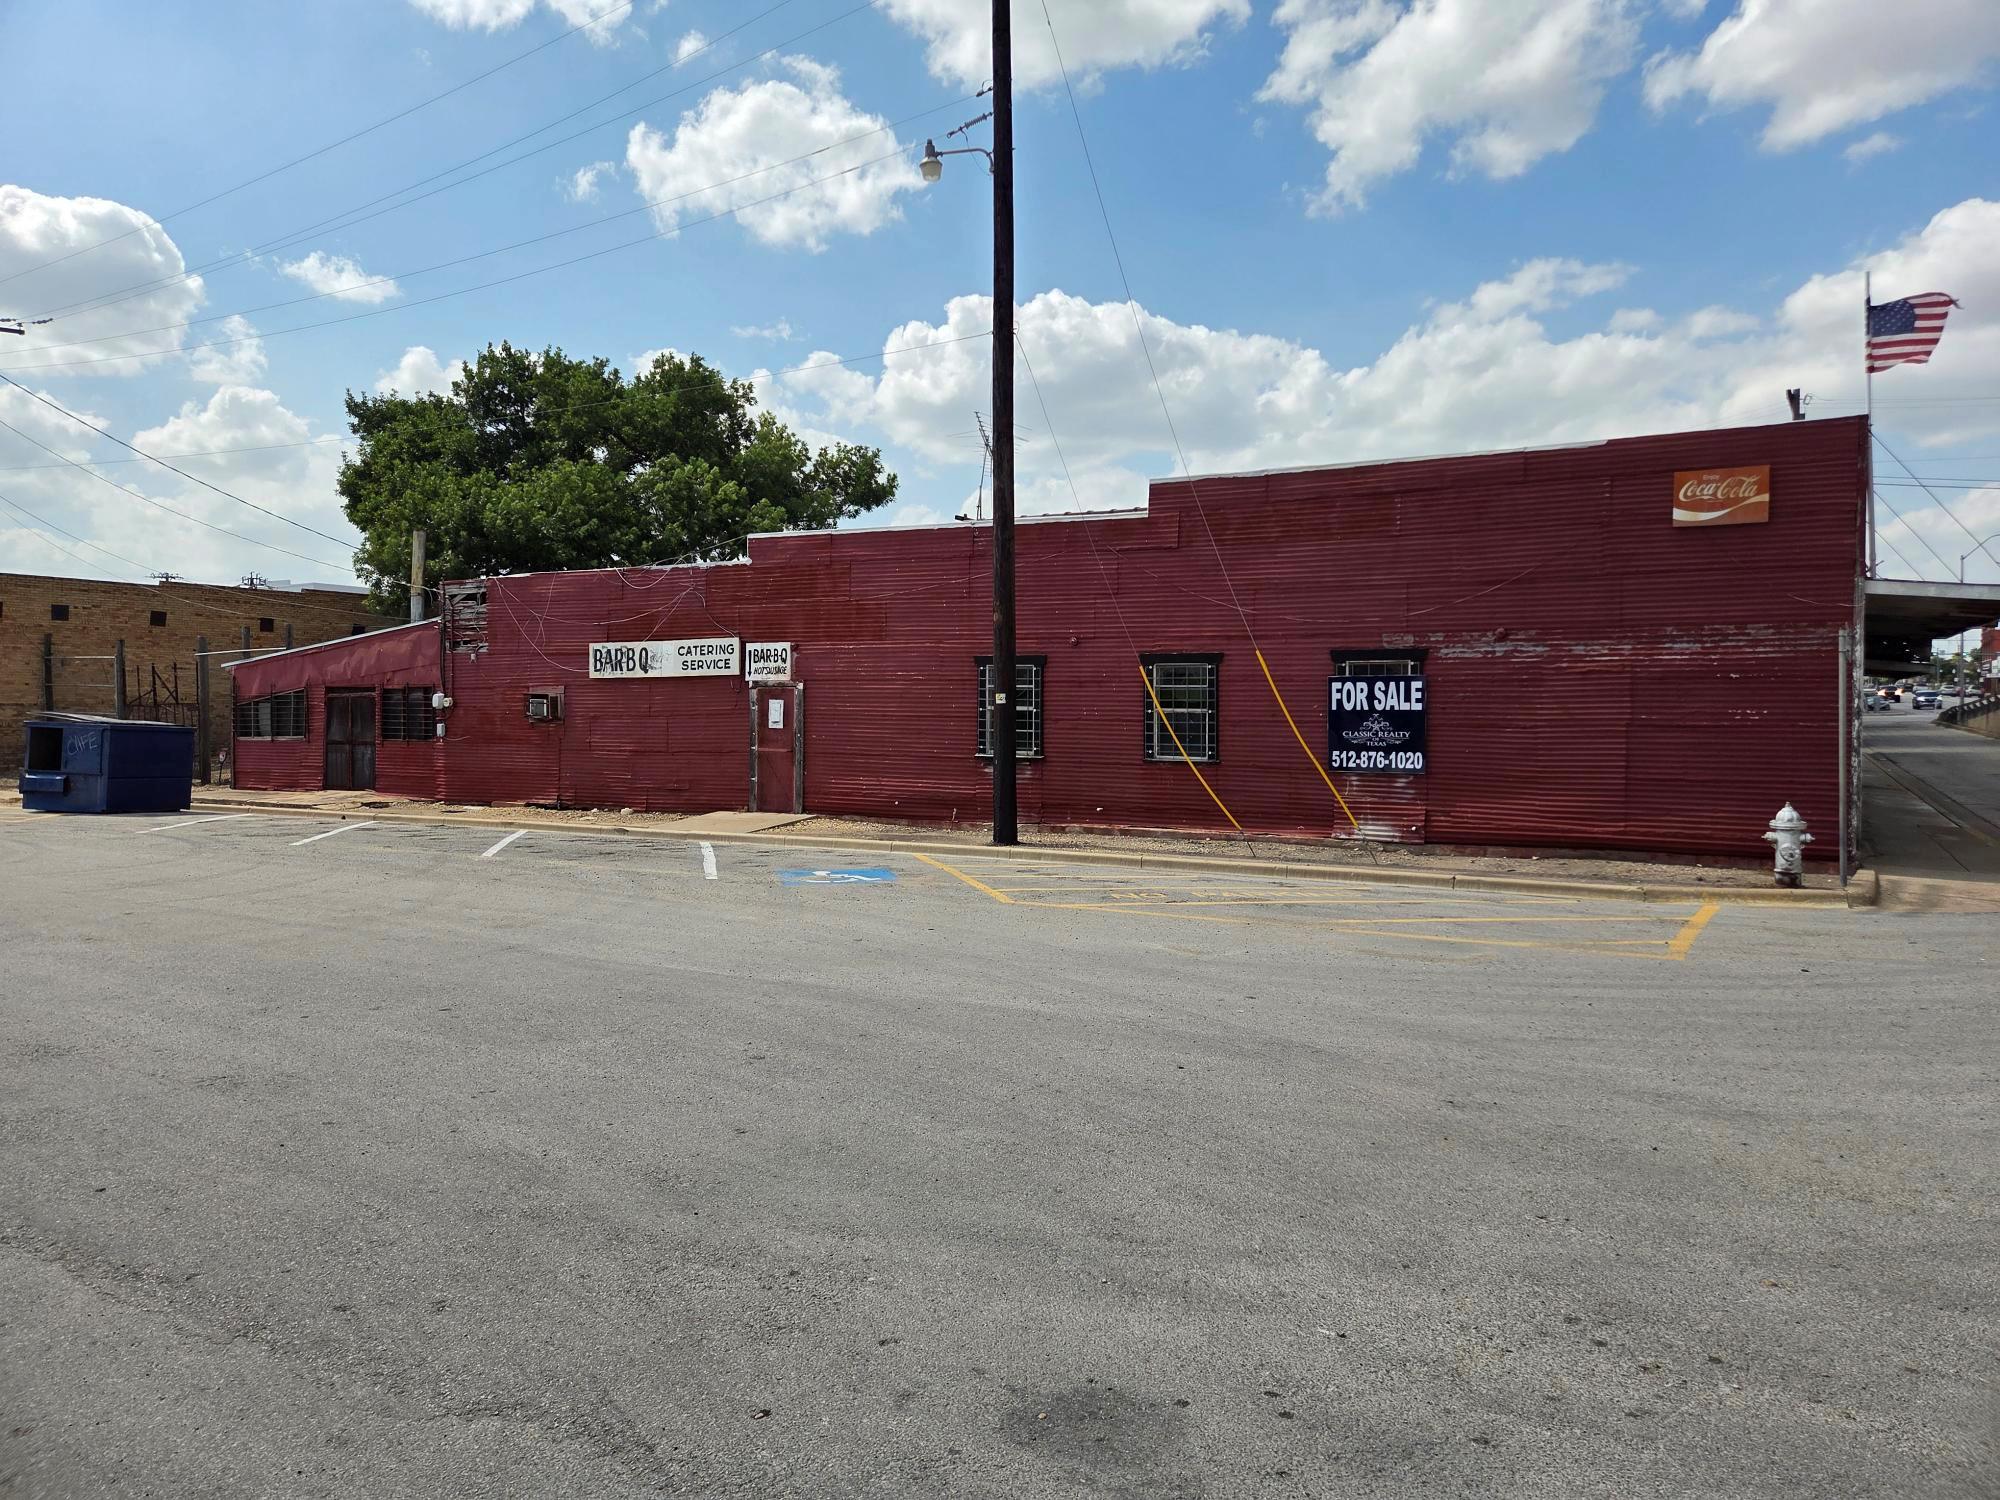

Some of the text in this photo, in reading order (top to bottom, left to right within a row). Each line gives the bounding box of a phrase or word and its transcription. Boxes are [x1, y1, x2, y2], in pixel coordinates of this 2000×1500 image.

[677, 643, 735, 657] CATERING
[753, 648, 788, 664] BAR-B-Q
[681, 658, 731, 671] SERVICE
[1331, 681, 1423, 711] FOR SALE
[1342, 730, 1376, 738] CLASSIC
[1332, 751, 1423, 770] 512-876-1020
